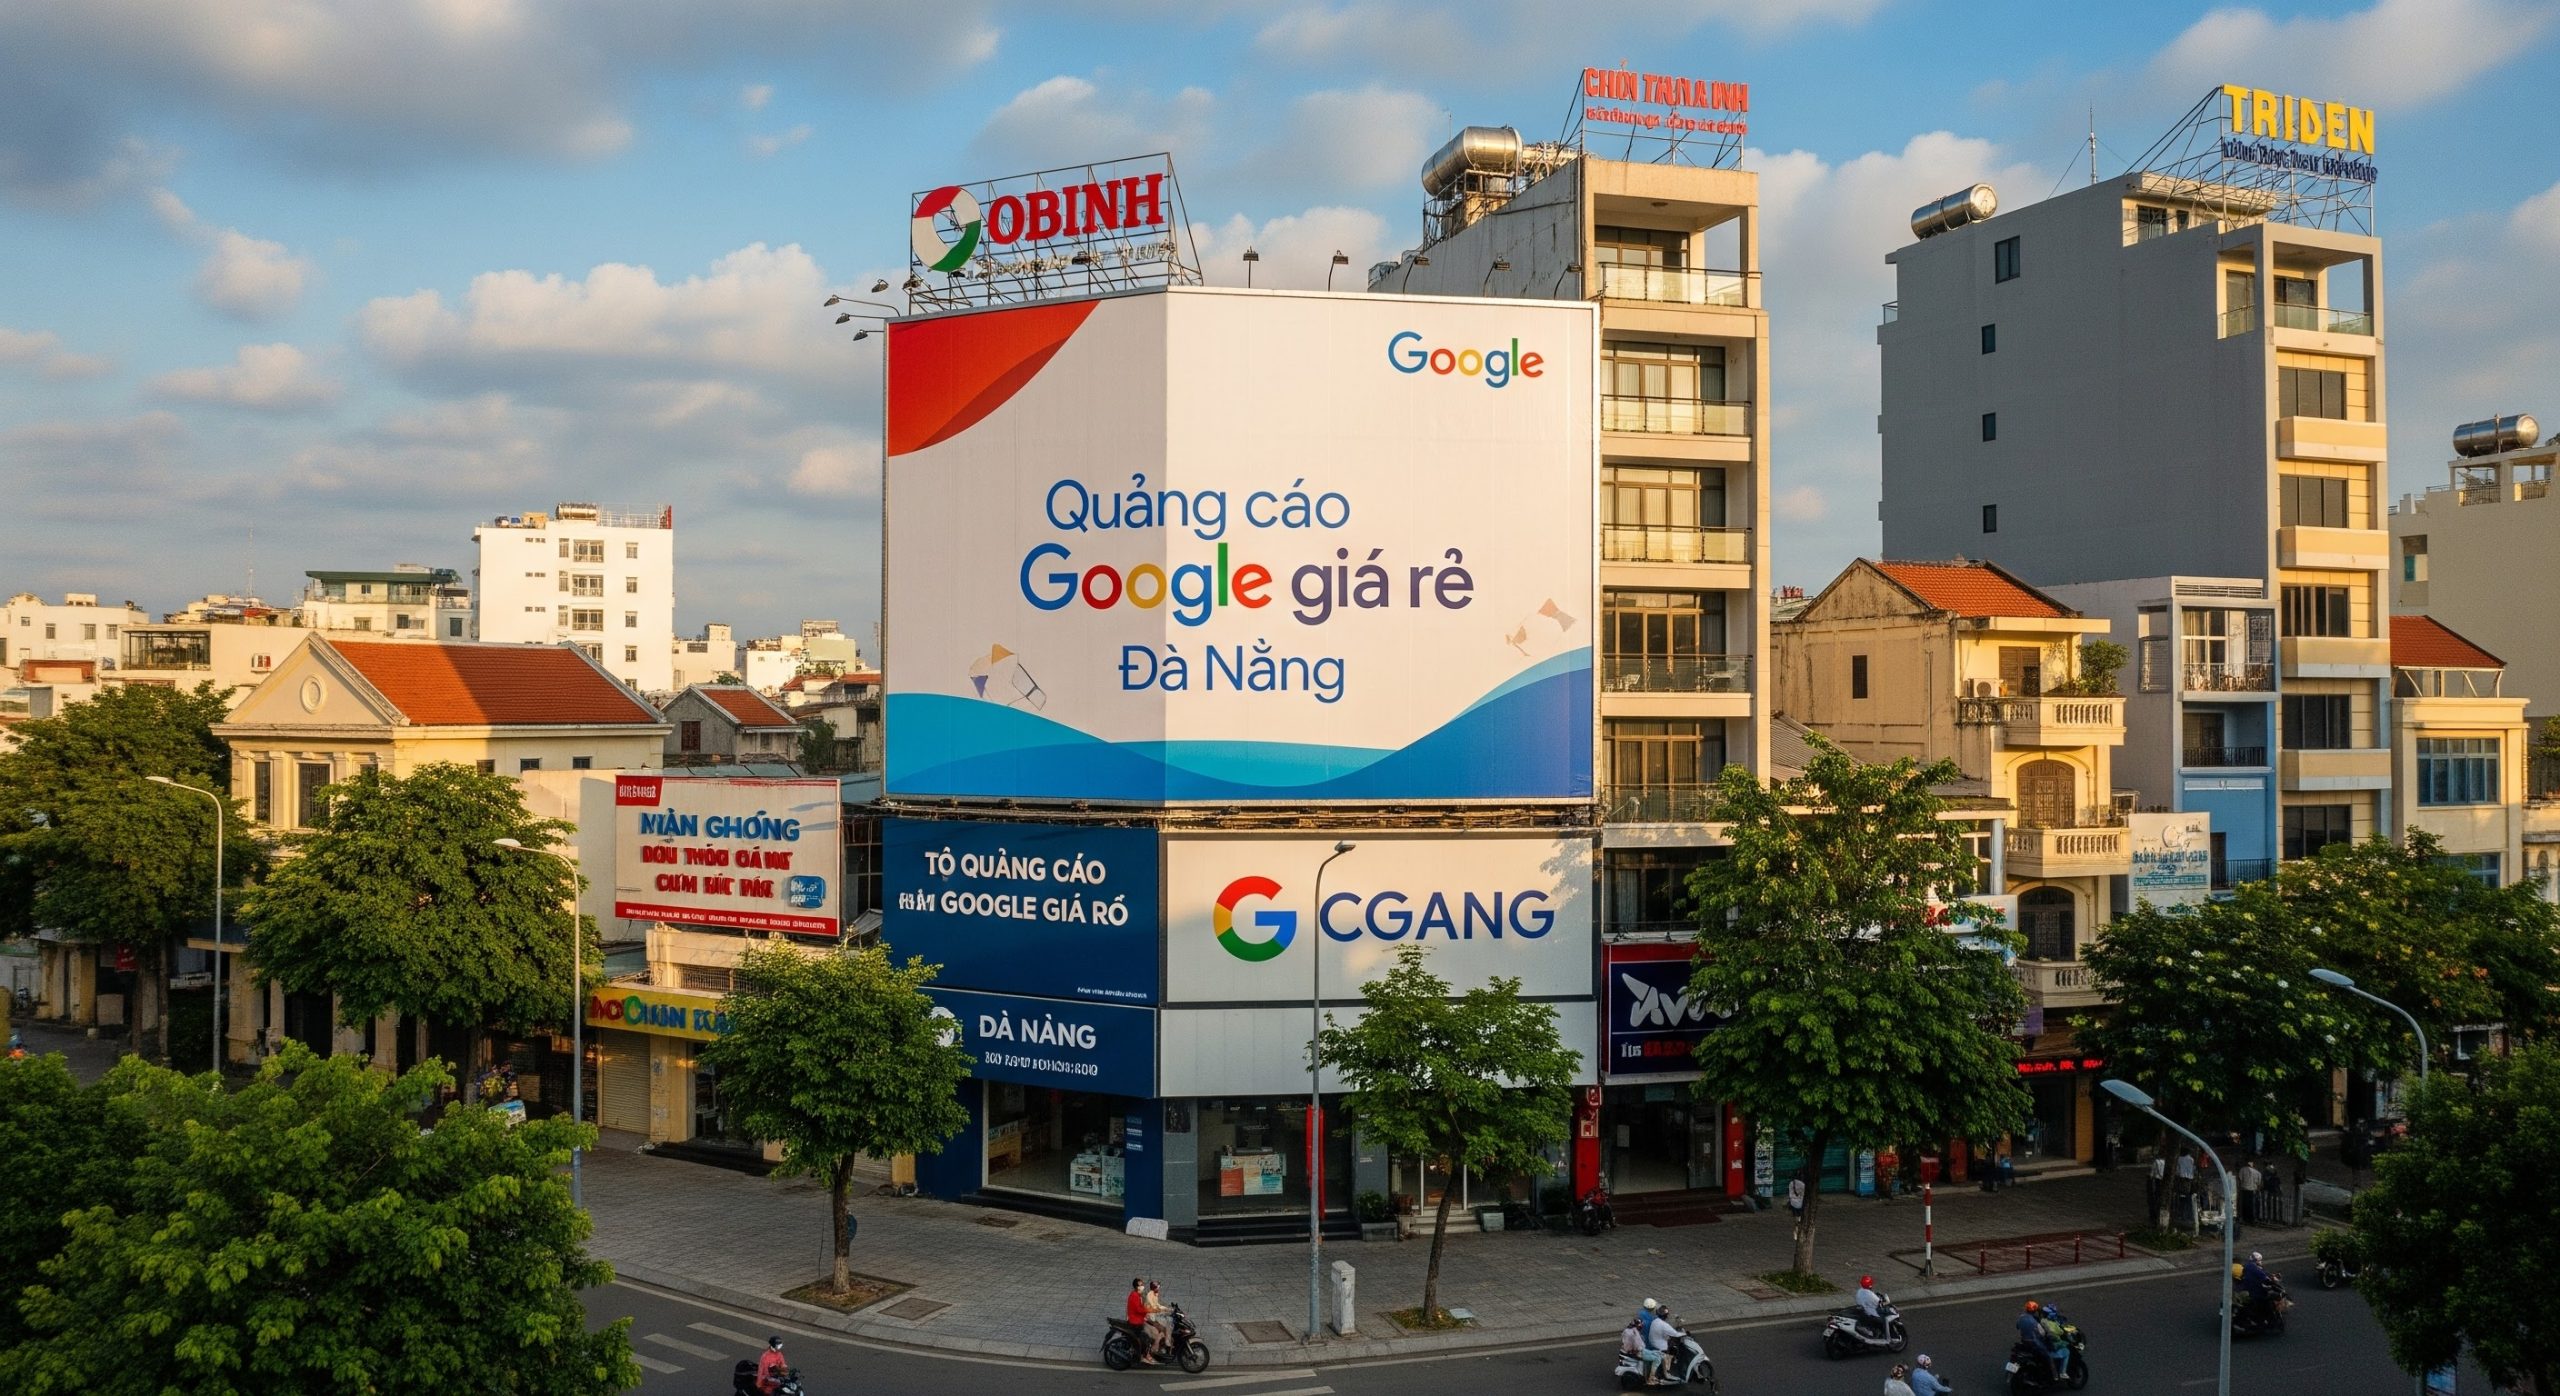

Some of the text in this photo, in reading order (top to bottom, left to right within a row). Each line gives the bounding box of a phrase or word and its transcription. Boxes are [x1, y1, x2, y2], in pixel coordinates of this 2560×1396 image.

[2222, 83, 2375, 155] TRIDEN
[988, 172, 1164, 245] OBINH
[1388, 331, 1544, 388] Google
[1046, 473, 1350, 540] Quảng cáo
[1019, 542, 1474, 627] Google giá rẻ
[1118, 638, 1345, 703] Đà Nằng
[960, 848, 1047, 882] QUẢNG
[1053, 853, 1107, 885] CÁO
[940, 891, 1037, 920] GOOGLE
[1042, 892, 1087, 924] GIÁ
[1320, 890, 1555, 943] CGANG
[979, 1010, 1015, 1042] DÀ
